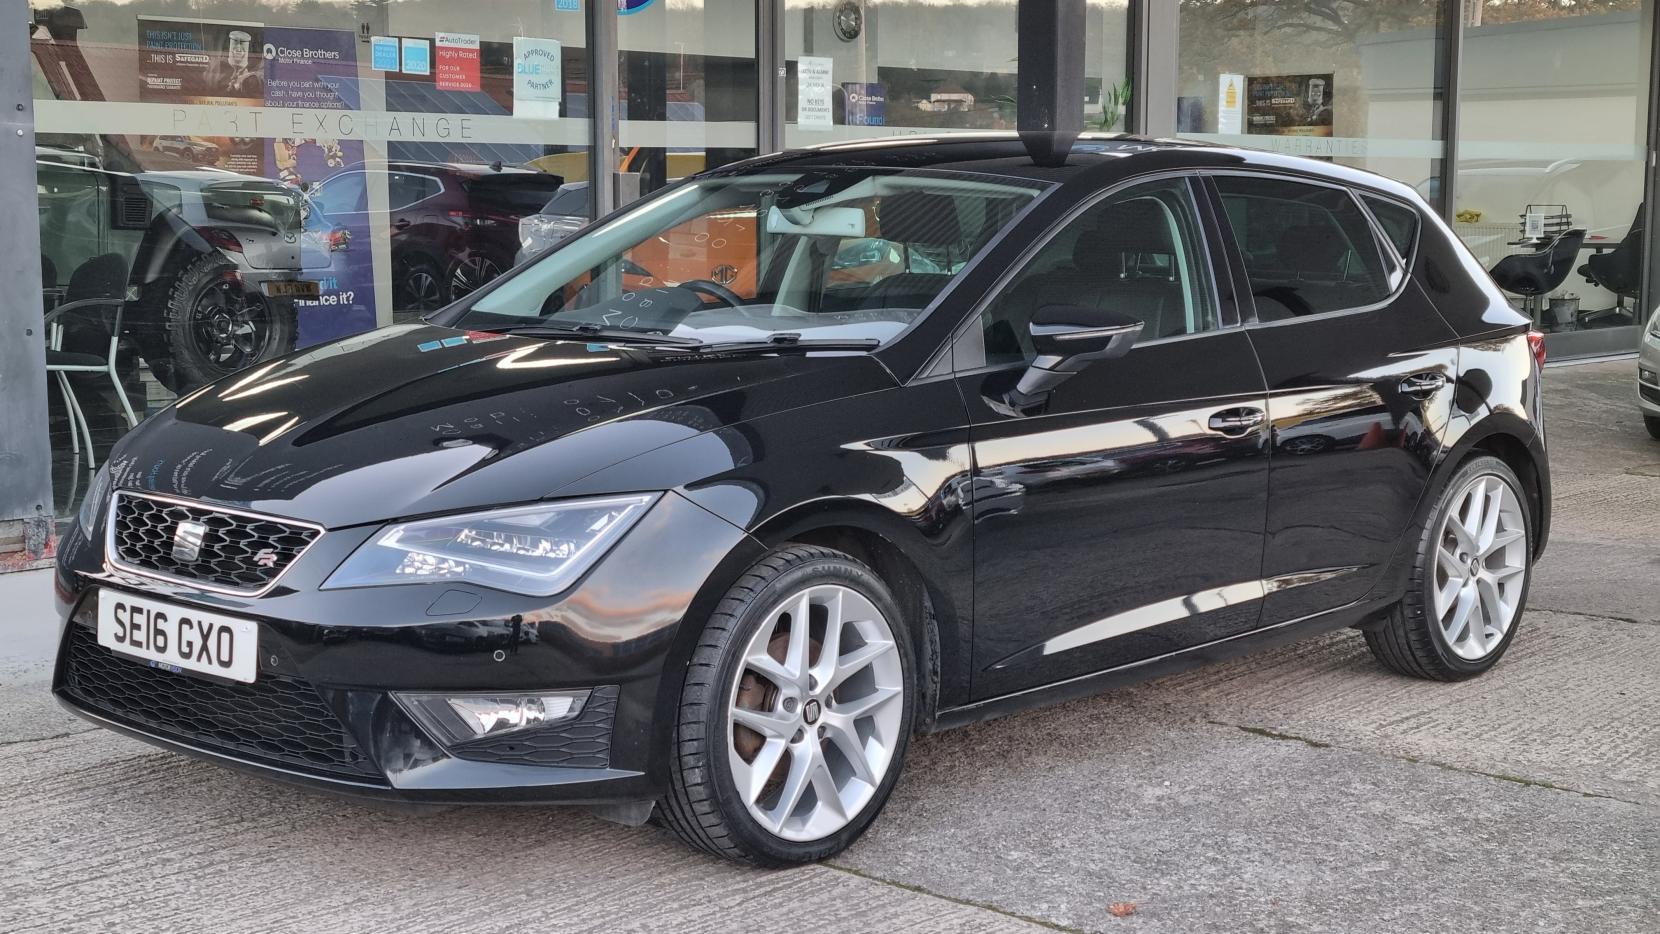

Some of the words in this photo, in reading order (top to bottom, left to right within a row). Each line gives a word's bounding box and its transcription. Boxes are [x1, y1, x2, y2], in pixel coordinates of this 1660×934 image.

[444, 36, 477, 46] AutoTrader
[277, 47, 302, 57] Close
[303, 48, 340, 59] Brothers
[439, 50, 459, 60] Highly
[459, 51, 477, 59] Rated
[523, 48, 555, 62] APPROVED
[517, 63, 540, 74] BLUE
[267, 79, 288, 87] Before
[288, 81, 300, 89] you
[300, 80, 313, 89] part
[313, 80, 326, 88] with
[527, 79, 554, 90] PARTNER
[270, 89, 288, 98] cash,
[288, 89, 303, 97] have
[303, 90, 315, 98] you
[315, 91, 338, 100] thought
[172, 109, 263, 133] PART
[291, 113, 472, 139] EXCHANGE
[1271, 138, 1367, 155] WARRANTIES
[339, 290, 355, 305] it?
[113, 602, 169, 654] SE16
[177, 616, 234, 669] GXO
